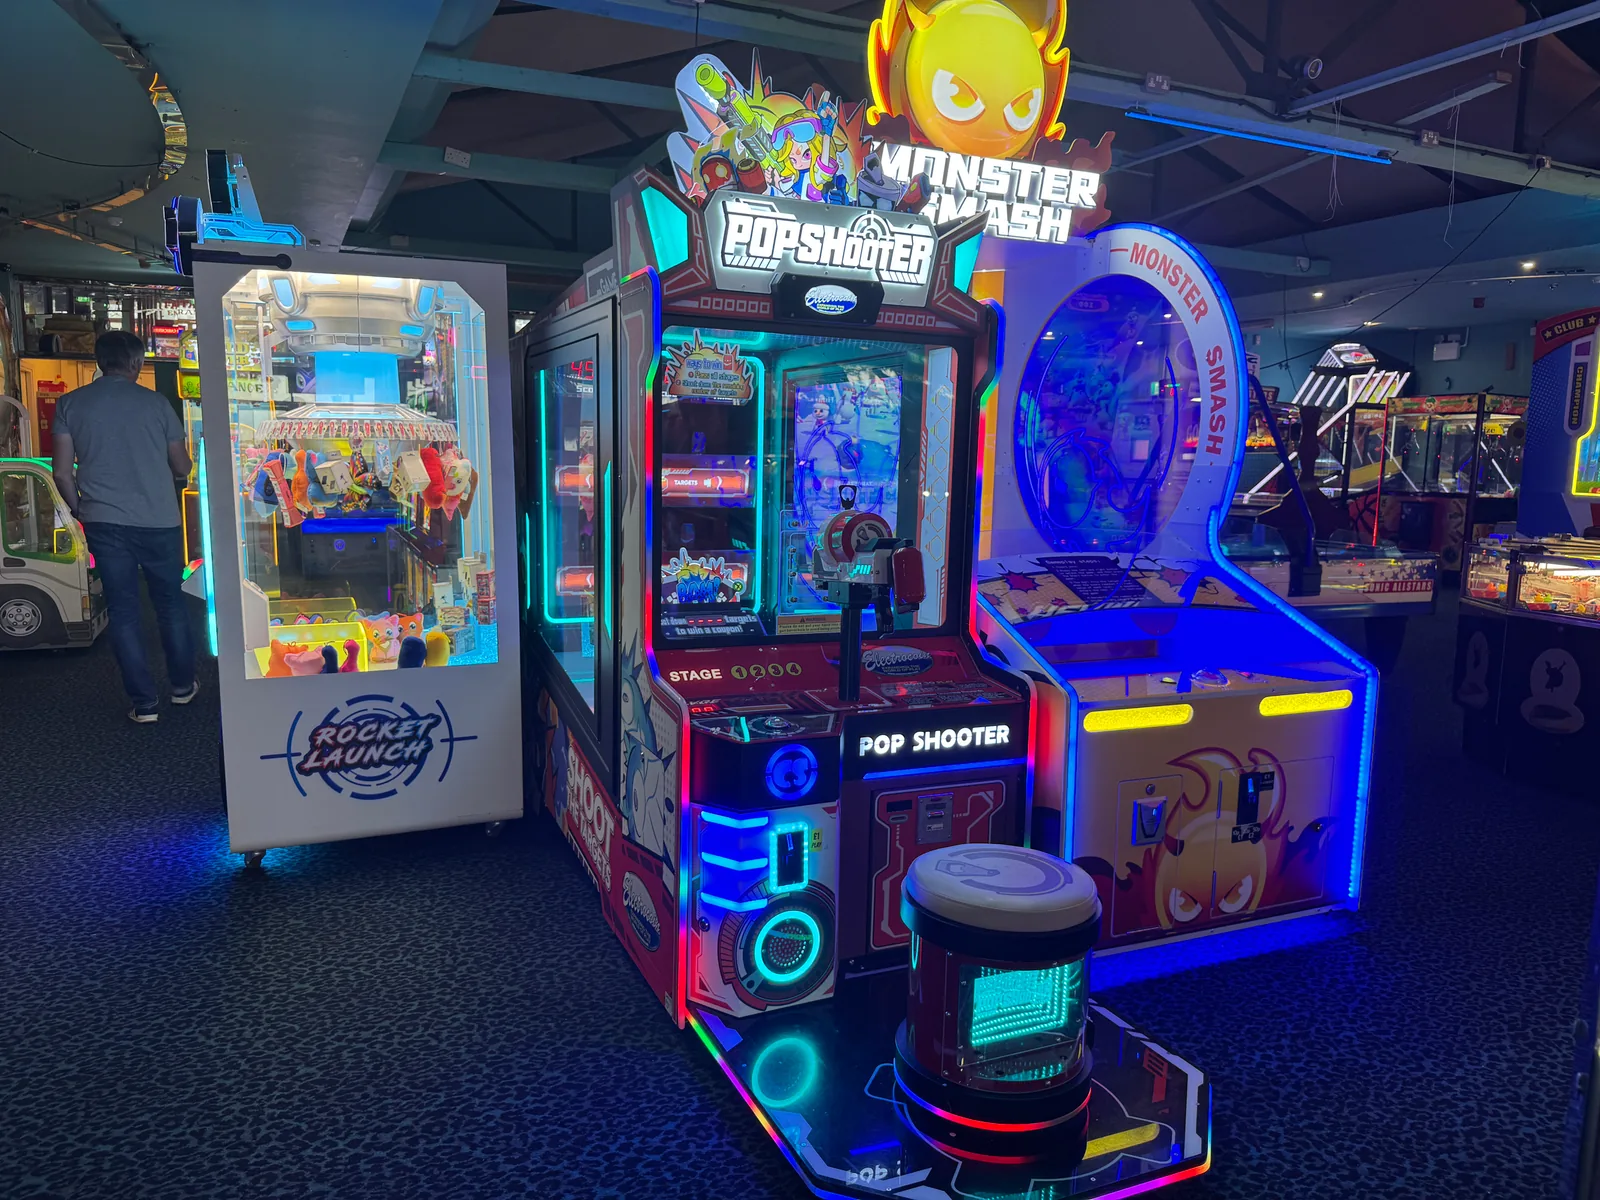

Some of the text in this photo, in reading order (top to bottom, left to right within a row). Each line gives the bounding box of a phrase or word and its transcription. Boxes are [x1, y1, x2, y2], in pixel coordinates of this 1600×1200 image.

[871, 141, 1100, 208] MONSTER
[1554, 318, 1584, 336] CLUB
[1129, 241, 1227, 456] MONSTER SMASH
[1572, 366, 1584, 425] CHAMPION
[1392, 581, 1432, 592] ALLSTARS
[675, 627, 686, 636] to
[686, 626, 703, 635] win
[724, 615, 758, 625] targets
[669, 664, 799, 682] STAGE 1 2 3 4
[315, 717, 438, 746] ROCKET
[859, 724, 1010, 757] POP SHOOTER
[302, 741, 423, 770] LAUNCH
[566, 785, 580, 828] THE
[567, 744, 615, 862] SHOOT
[579, 810, 611, 892] TARGETS
